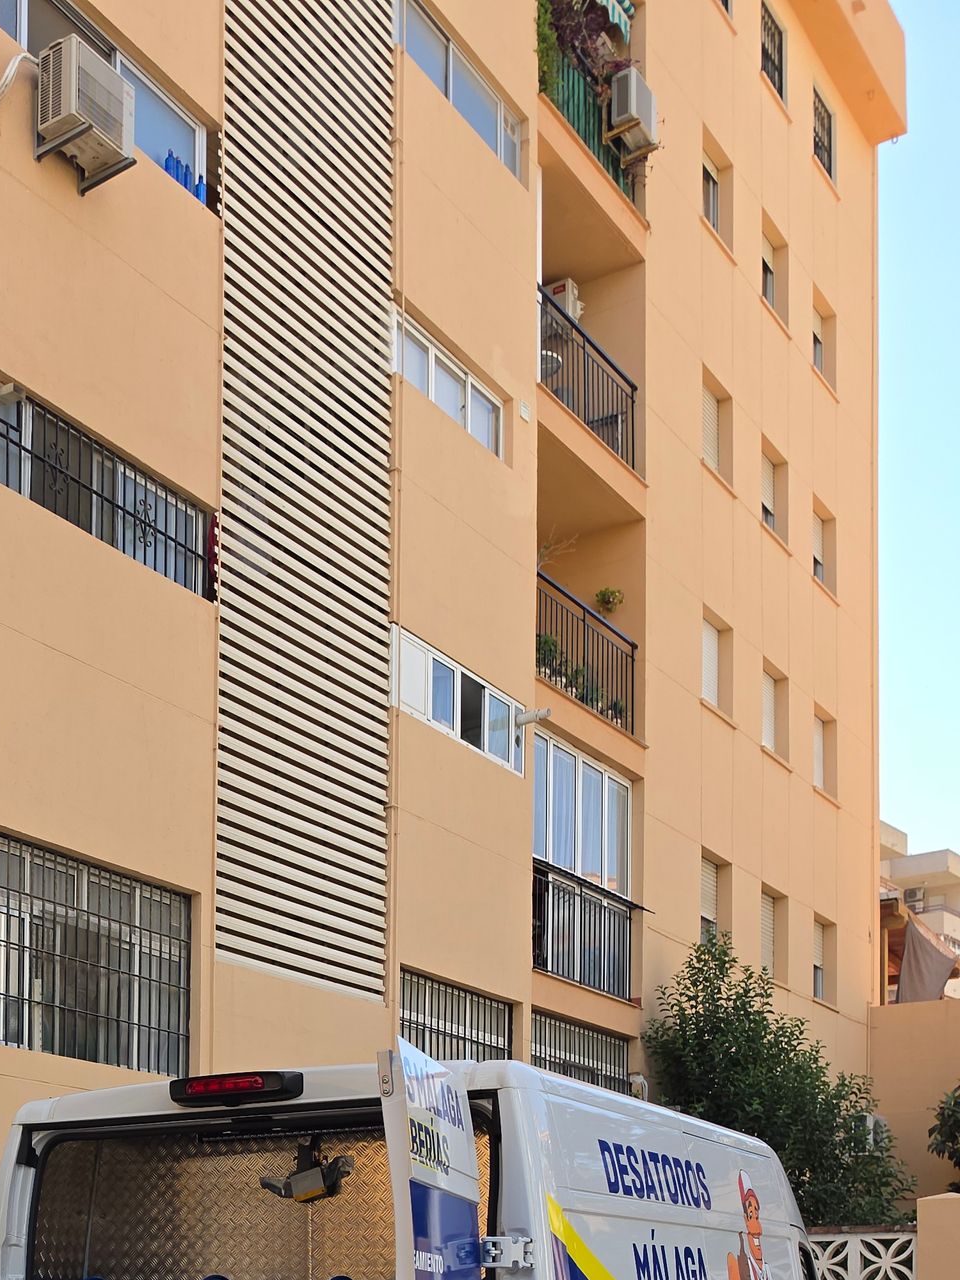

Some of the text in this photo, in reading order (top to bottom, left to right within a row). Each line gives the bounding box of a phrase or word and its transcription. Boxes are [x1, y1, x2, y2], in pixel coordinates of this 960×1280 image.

[413, 1059, 464, 1131] MÁLAGA
[409, 1117, 450, 1176] BERÍAS
[597, 1138, 712, 1211] DESATOROS
